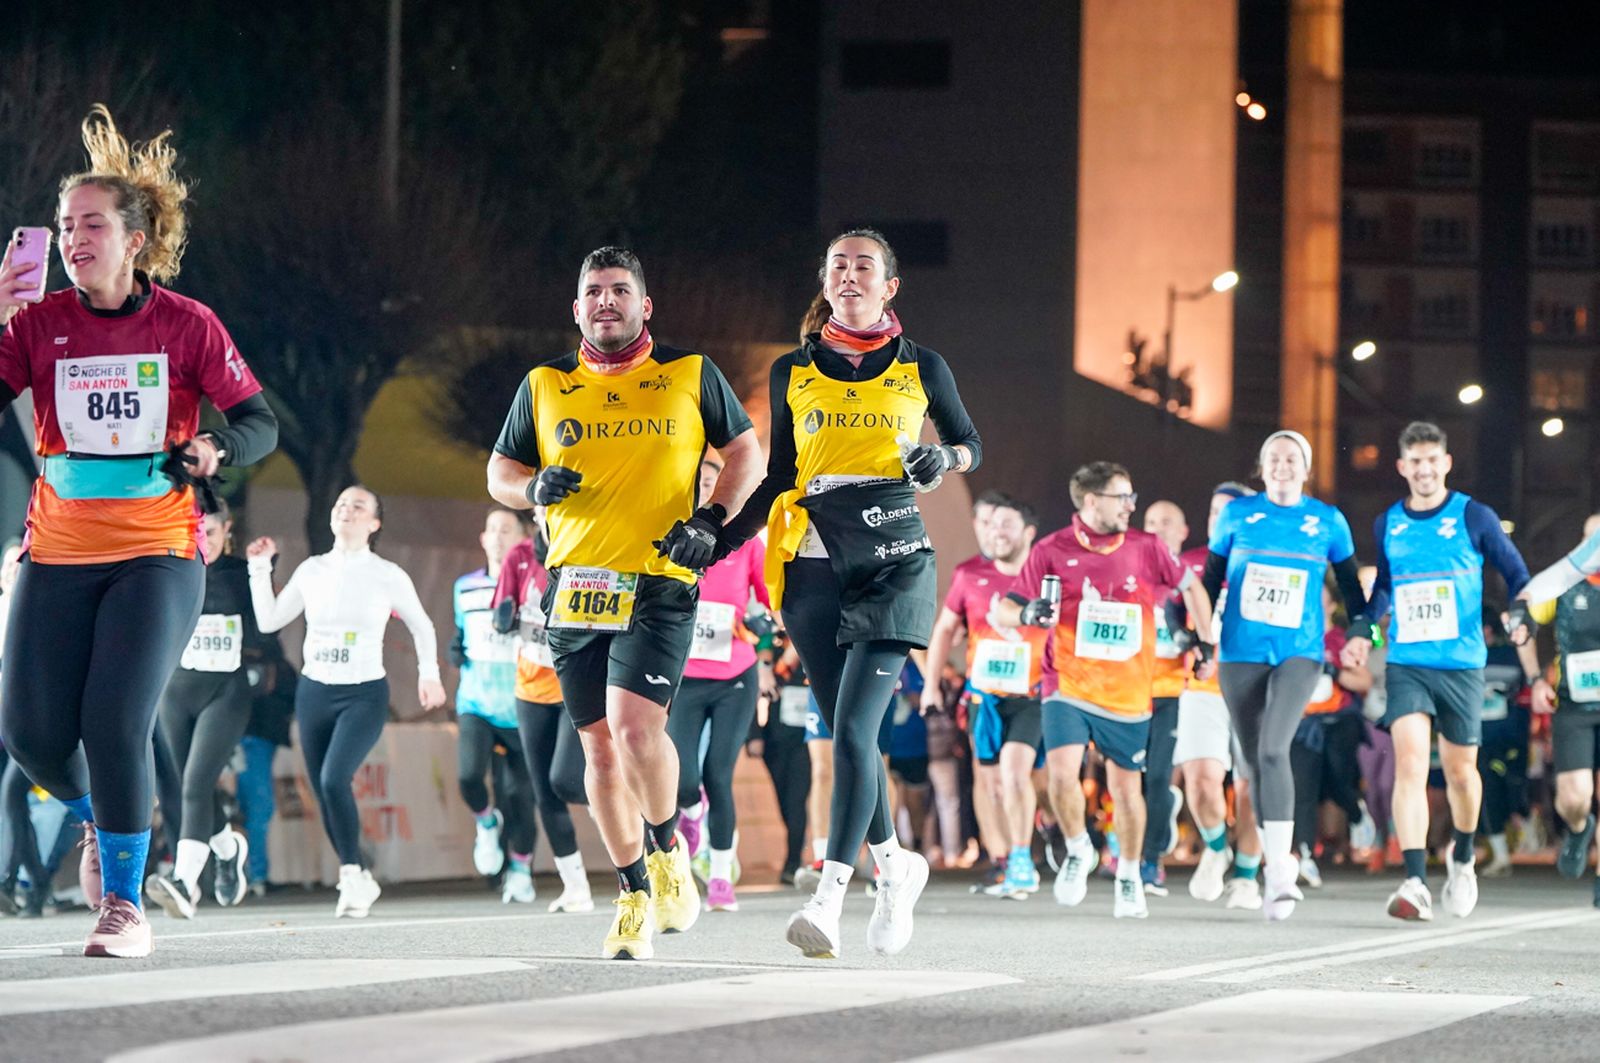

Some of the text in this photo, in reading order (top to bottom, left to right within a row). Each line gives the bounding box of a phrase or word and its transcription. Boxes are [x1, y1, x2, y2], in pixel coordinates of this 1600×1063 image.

[81, 366, 127, 377] NOCHE DE
[69, 380, 90, 391] SAN
[87, 391, 140, 420] 845
[804, 409, 906, 434] AIRZONE
[555, 417, 677, 447] AIRZONE
[568, 591, 621, 615] 4164
[1256, 586, 1290, 605] 2477
[1408, 603, 1442, 622] 2479
[1093, 622, 1128, 641] 7812
[192, 636, 232, 651] 3999
